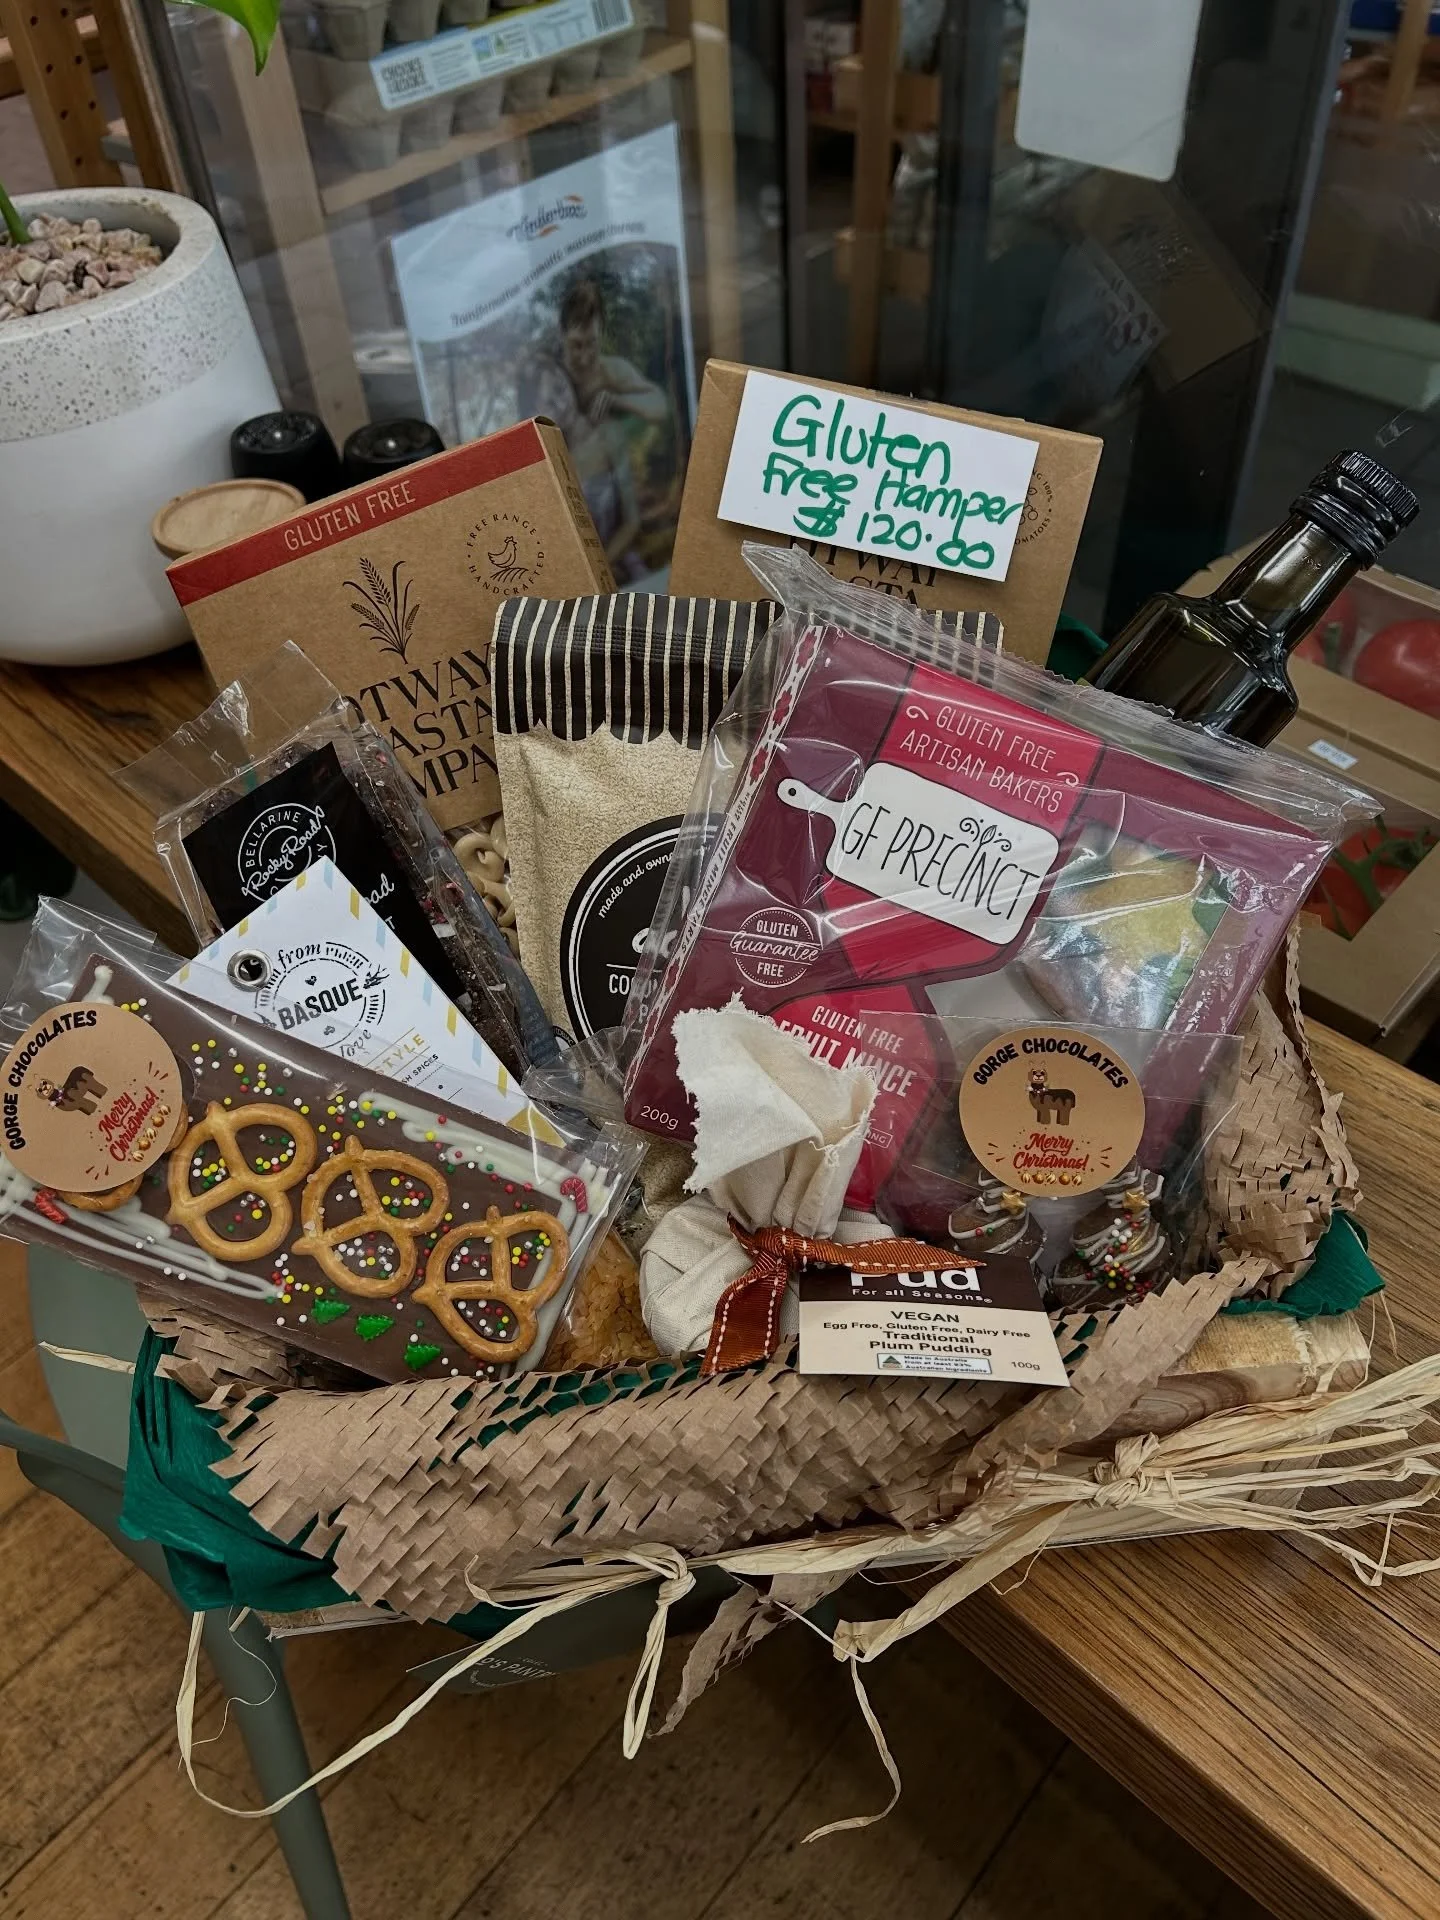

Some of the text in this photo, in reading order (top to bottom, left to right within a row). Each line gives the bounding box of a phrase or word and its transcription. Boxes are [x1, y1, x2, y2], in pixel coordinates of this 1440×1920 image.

[772, 394, 951, 485] Gluten
[283, 480, 416, 552] GLUTEN FREE
[763, 452, 1024, 542] Free Hamper
[466, 513, 537, 547] FREE RANGE
[1014, 517, 1051, 545] OMATOES
[468, 551, 545, 596] HANDCRAFTED
[388, 696, 493, 758] ASTA
[936, 705, 1058, 774] GLUTEN FREE
[899, 729, 1065, 814] ARTISAN BAKERS
[241, 805, 325, 897] Rocky Road
[245, 810, 301, 868] BELLARINE
[841, 802, 1040, 921] GF PRECINCT
[598, 885, 624, 918] made
[622, 865, 645, 888] and
[729, 930, 820, 963] Guarantee
[756, 919, 799, 938] GLUTEN
[277, 943, 321, 973] from
[756, 962, 784, 978] FREE
[278, 978, 364, 1031] BASQUE
[811, 1005, 905, 1054] GLUTEN FREE
[3, 1010, 97, 1150] GORGE CHOCOLATES
[412, 1053, 439, 1076] SPICES
[973, 1037, 1129, 1089] GORGE CHOCOLATES
[98, 1091, 137, 1142] Merry
[640, 1104, 679, 1130] 200g
[1024, 1132, 1075, 1156] Merry
[852, 1288, 877, 1297] For
[885, 1288, 904, 1297] all
[823, 1321, 1031, 1339] Egg Free, Gluten Free, Dairy Free
[883, 1330, 975, 1343] Traditional
[890, 1310, 960, 1323] VEGAN
[869, 1341, 993, 1357] Plum Pudding
[1011, 1360, 1041, 1371] 100g
